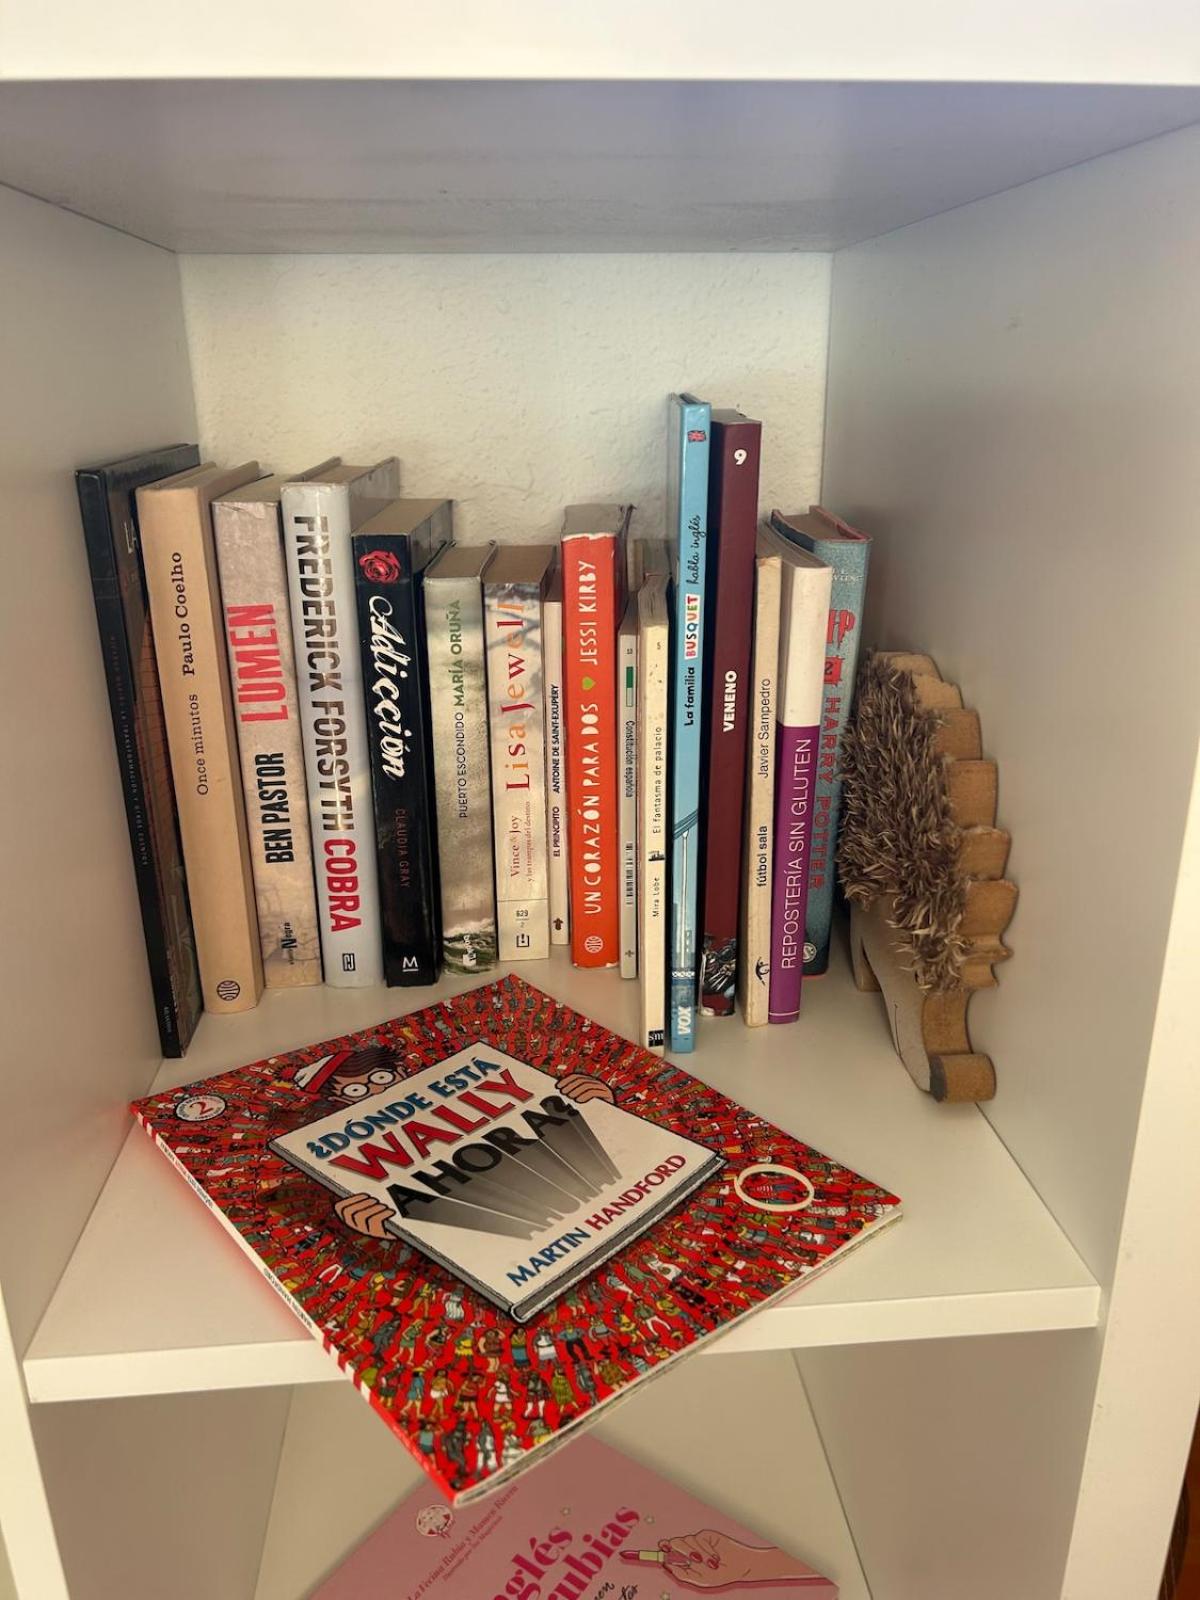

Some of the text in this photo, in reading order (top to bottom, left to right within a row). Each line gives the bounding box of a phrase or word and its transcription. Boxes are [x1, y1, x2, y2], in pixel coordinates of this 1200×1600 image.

[734, 449, 747, 465] 9
[170, 552, 194, 676] Paulo Coelho
[227, 603, 289, 722] LUMEN
[578, 560, 598, 665] JESSI KIRBY
[684, 515, 707, 726] La familia BUSQUET habla inglés
[294, 516, 354, 831] FREDERICK FORSYTH
[368, 595, 412, 780] Adicción
[445, 600, 469, 818] PUERTO ESCONDIDO MARÍA ORUÑA
[497, 603, 536, 791] Lisa Jewell
[723, 670, 738, 733] VENENO
[189, 694, 208, 796] Once minutos
[550, 684, 560, 793] ANTOINE DE SAINT-EXUPÉRY
[653, 727, 663, 834] El fantasma de palacio
[758, 678, 772, 778] Javier Sampedro
[255, 752, 294, 864] BEN PASTOR
[509, 816, 522, 834] Joy
[577, 703, 602, 915] UN CORAZÓN PARA DOS
[809, 697, 841, 890] HARRY POTTER
[324, 838, 362, 932] COBRA
[395, 809, 411, 888] CLAUDIA GRAY
[510, 845, 520, 877] Vince
[553, 848, 560, 857] EL
[756, 825, 767, 887] fútbol sala
[781, 738, 812, 969] REPOSTERÍA SIN GLUTEN
[678, 1006, 692, 1035] VOX
[190, 1101, 214, 1115] 2
[306, 1057, 501, 1160] ¿DÓNDE ESTÁ
[329, 1068, 535, 1182] WALLY
[386, 1094, 580, 1218] AHORA?
[506, 1154, 687, 1287] MARTIN HANDFORD
